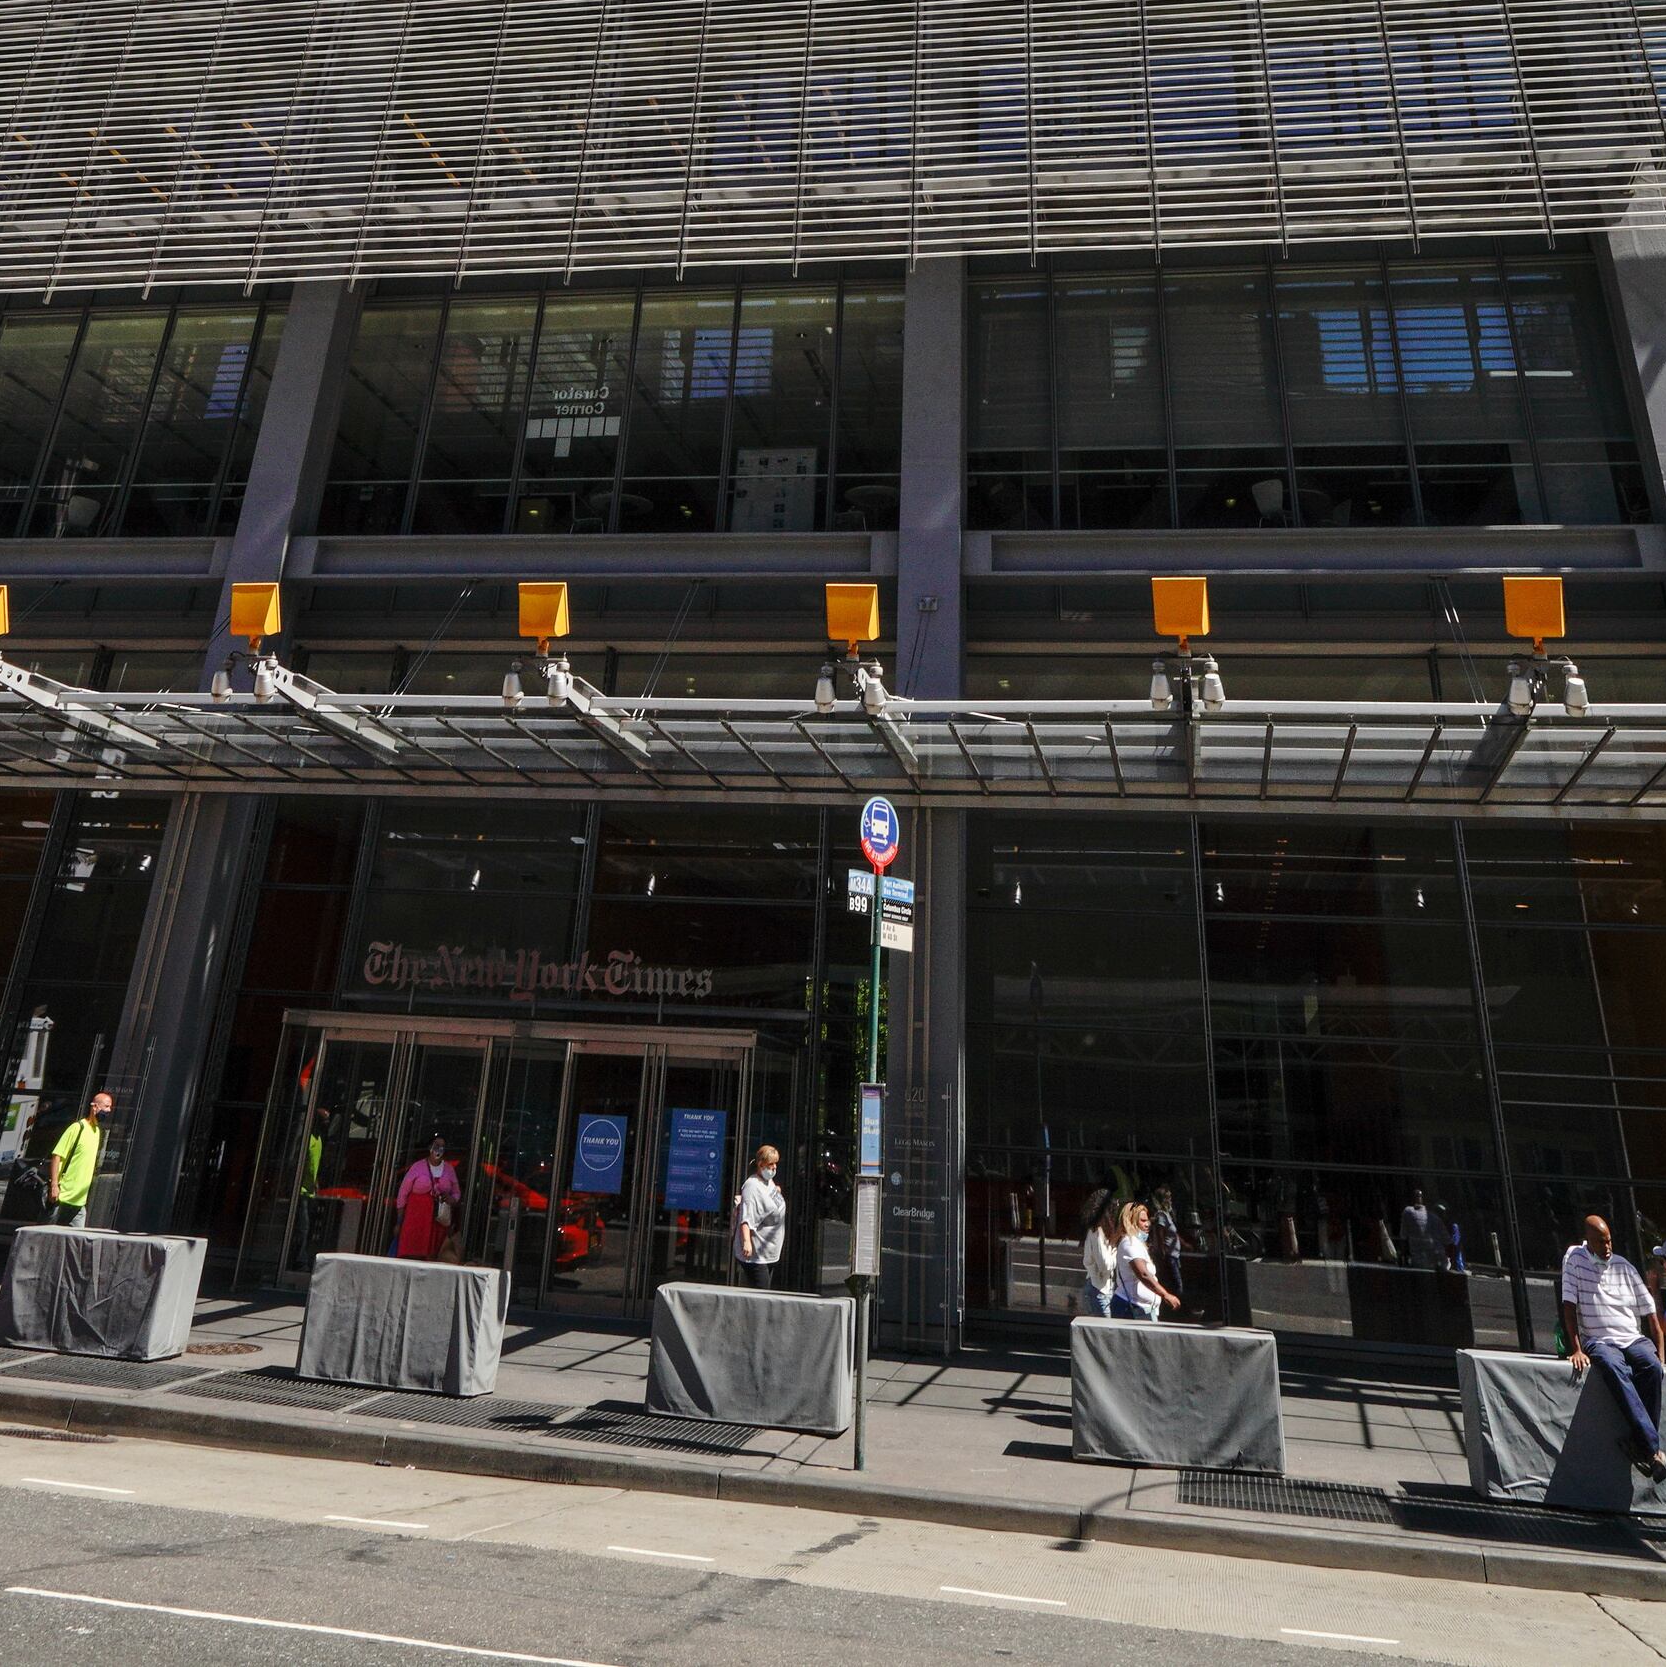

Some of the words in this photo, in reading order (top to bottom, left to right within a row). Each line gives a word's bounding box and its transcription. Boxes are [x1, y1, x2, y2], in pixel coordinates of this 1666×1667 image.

[849, 877, 872, 893] M34A
[849, 896, 868, 913] B99
[363, 941, 427, 991] The
[429, 945, 506, 990] New
[509, 948, 599, 1002] York
[603, 949, 714, 999] Times
[583, 1136, 606, 1145] THANK
[605, 1137, 620, 1146] YOU
[893, 1205, 935, 1220] ClearBridge
